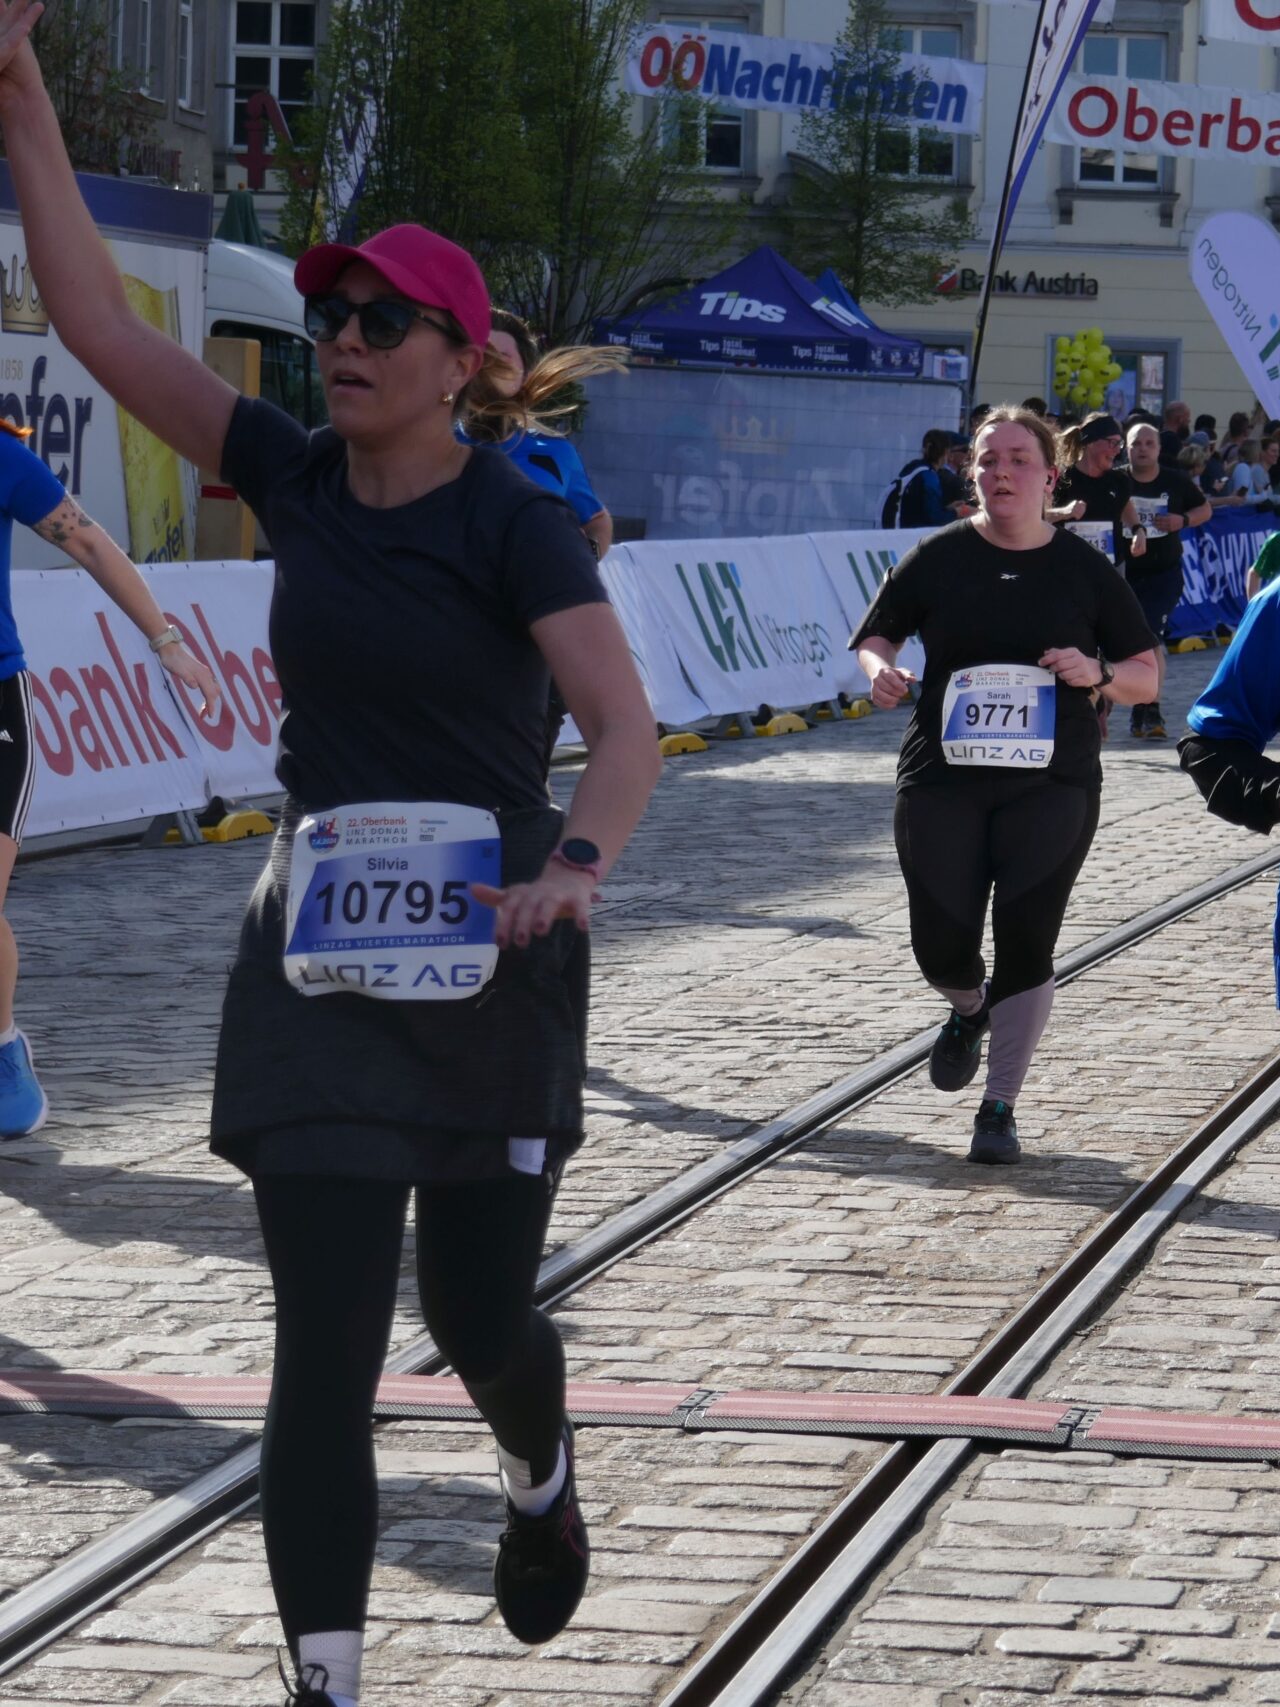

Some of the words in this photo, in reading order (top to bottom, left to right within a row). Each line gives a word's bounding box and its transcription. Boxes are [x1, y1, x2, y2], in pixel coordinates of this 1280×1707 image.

[640, 33, 967, 123] OÖNachrichten
[1022, 270, 1099, 296] Austria
[700, 292, 787, 324] Tips
[987, 692, 1011, 700] Sarah
[965, 704, 1028, 728] 9771
[950, 746, 1004, 759] LINZ
[1010, 748, 1046, 761] AG
[361, 816, 407, 827] Oberbank
[346, 828, 366, 836] LINZ
[370, 827, 408, 835] DONAU
[345, 836, 408, 846] MARATHON
[367, 858, 409, 871] Silvia
[316, 880, 469, 925] 10795
[356, 935, 466, 947] VIERTELMARATHON
[298, 963, 399, 988] LINZ
[412, 963, 483, 988] AG
